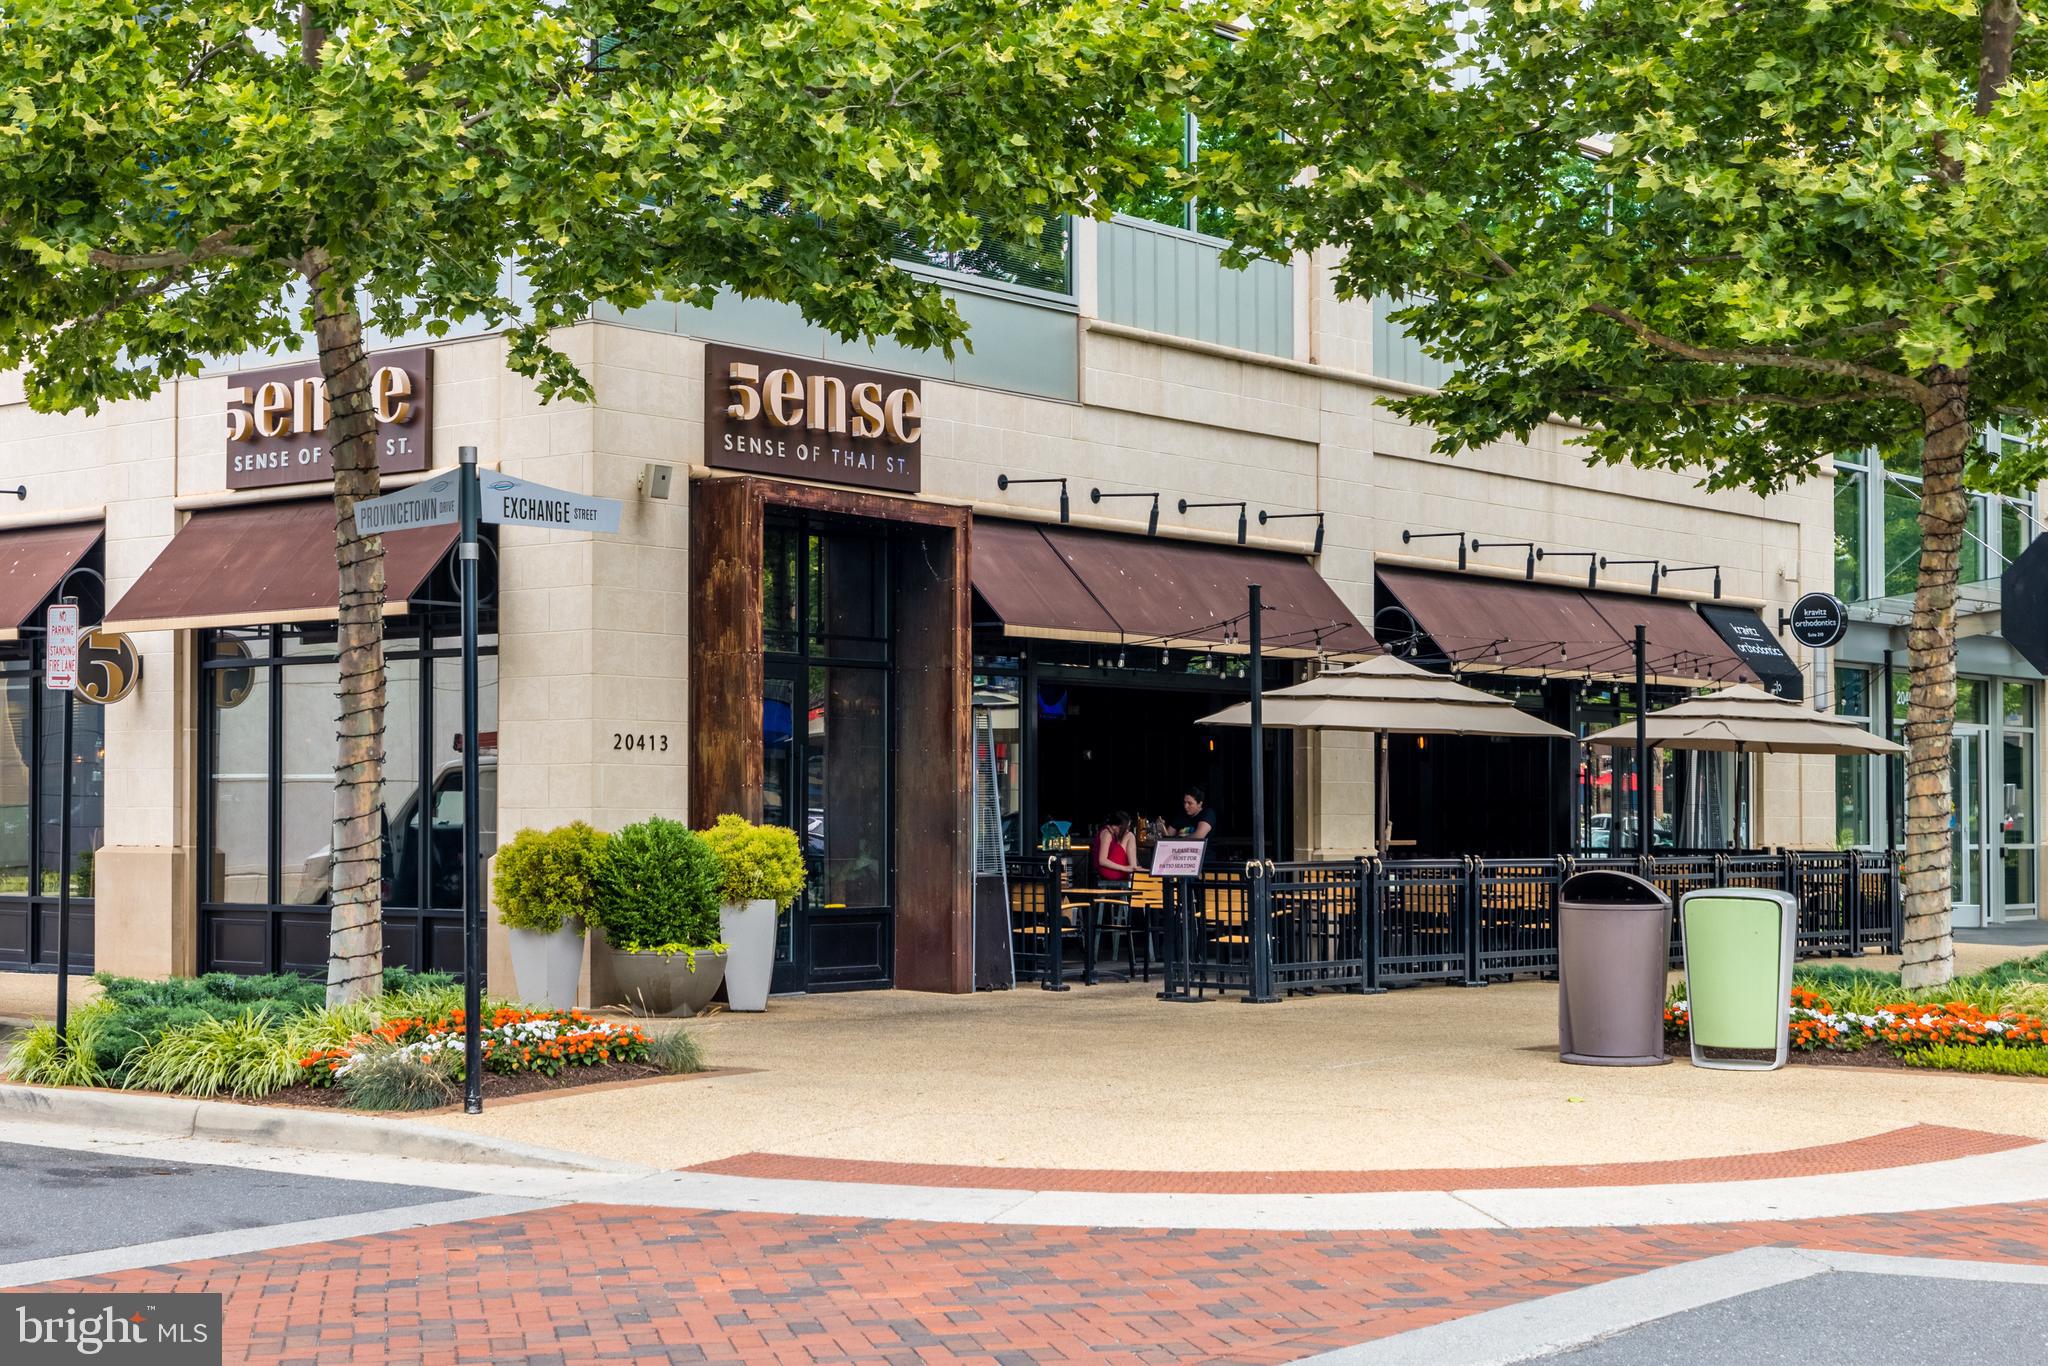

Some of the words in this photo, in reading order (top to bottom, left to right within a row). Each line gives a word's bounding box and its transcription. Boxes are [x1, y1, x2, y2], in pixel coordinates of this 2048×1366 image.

[225, 366, 411, 441] 5ene
[727, 361, 922, 444] 5ense
[234, 450, 289, 472] SENSE
[298, 446, 322, 466] OF
[386, 437, 413, 456] ST.
[723, 433, 786, 458] SENSE
[796, 443, 820, 462] OF
[831, 448, 875, 471] THAI
[886, 457, 910, 476] ST.
[360, 498, 437, 529] PROVINCETOWN
[439, 500, 455, 514] DRIVE
[503, 496, 570, 524] EXCHANGE
[573, 507, 598, 522] STREET
[59, 610, 66, 622] NO
[1803, 608, 1827, 616] kravitz
[52, 626, 74, 636] PARKING
[1794, 619, 1837, 628] orthodontics
[49, 645, 76, 656] STANDING
[1737, 642, 1784, 656] orthodontics
[49, 659, 60, 672] FIRE
[62, 659, 76, 672] LANE
[613, 732, 668, 752] 20413
